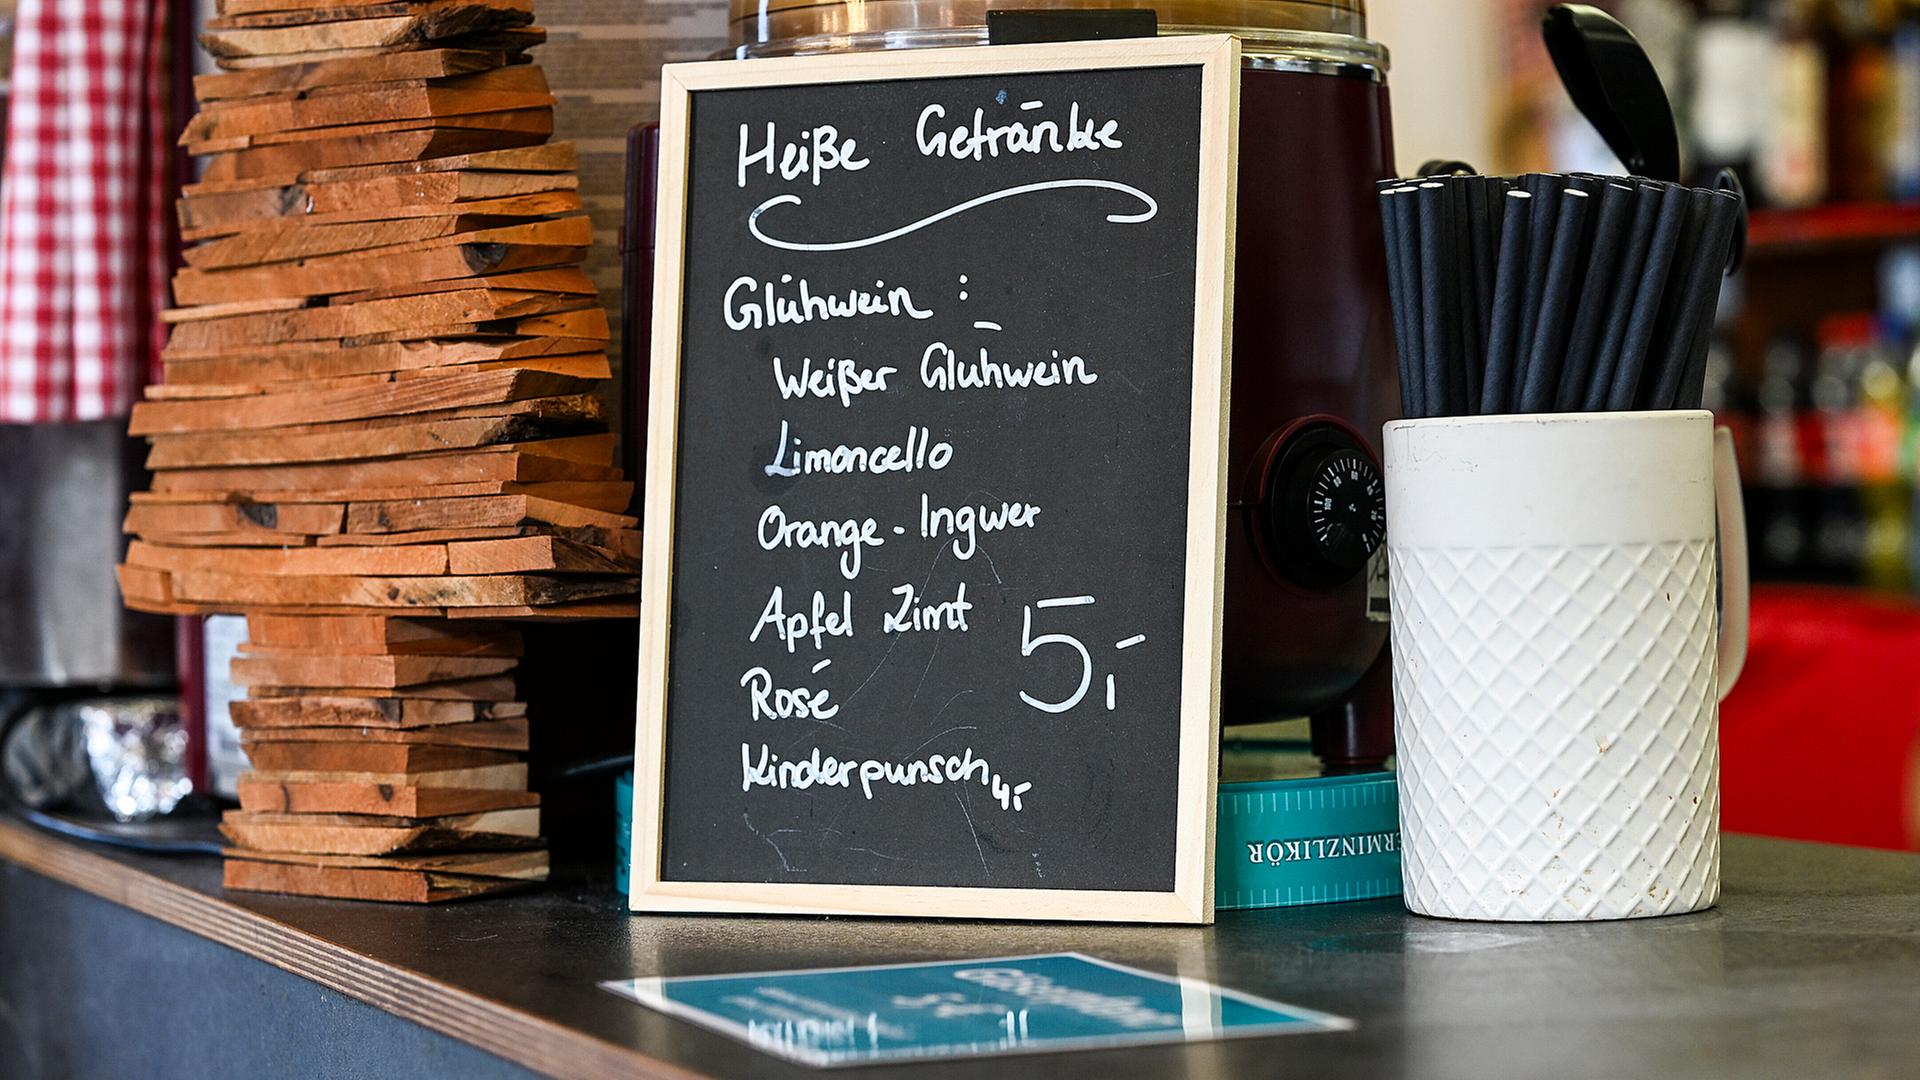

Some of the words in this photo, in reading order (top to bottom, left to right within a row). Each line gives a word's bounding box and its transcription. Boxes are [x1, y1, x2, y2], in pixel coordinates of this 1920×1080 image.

[738, 121, 870, 188] Heiße
[915, 100, 1123, 162] Getränke
[723, 273, 934, 331] Glühwein
[773, 357, 898, 408] Weißer
[919, 321, 1098, 392] Glühwein
[764, 419, 954, 477] Limoncello
[757, 504, 885, 580] Orange
[920, 493, 1042, 561] Ingwer
[749, 585, 854, 654] Apfel
[883, 581, 973, 634] Zimt
[740, 658, 840, 722] Rosé
[741, 741, 990, 800] Kinderpunsch
